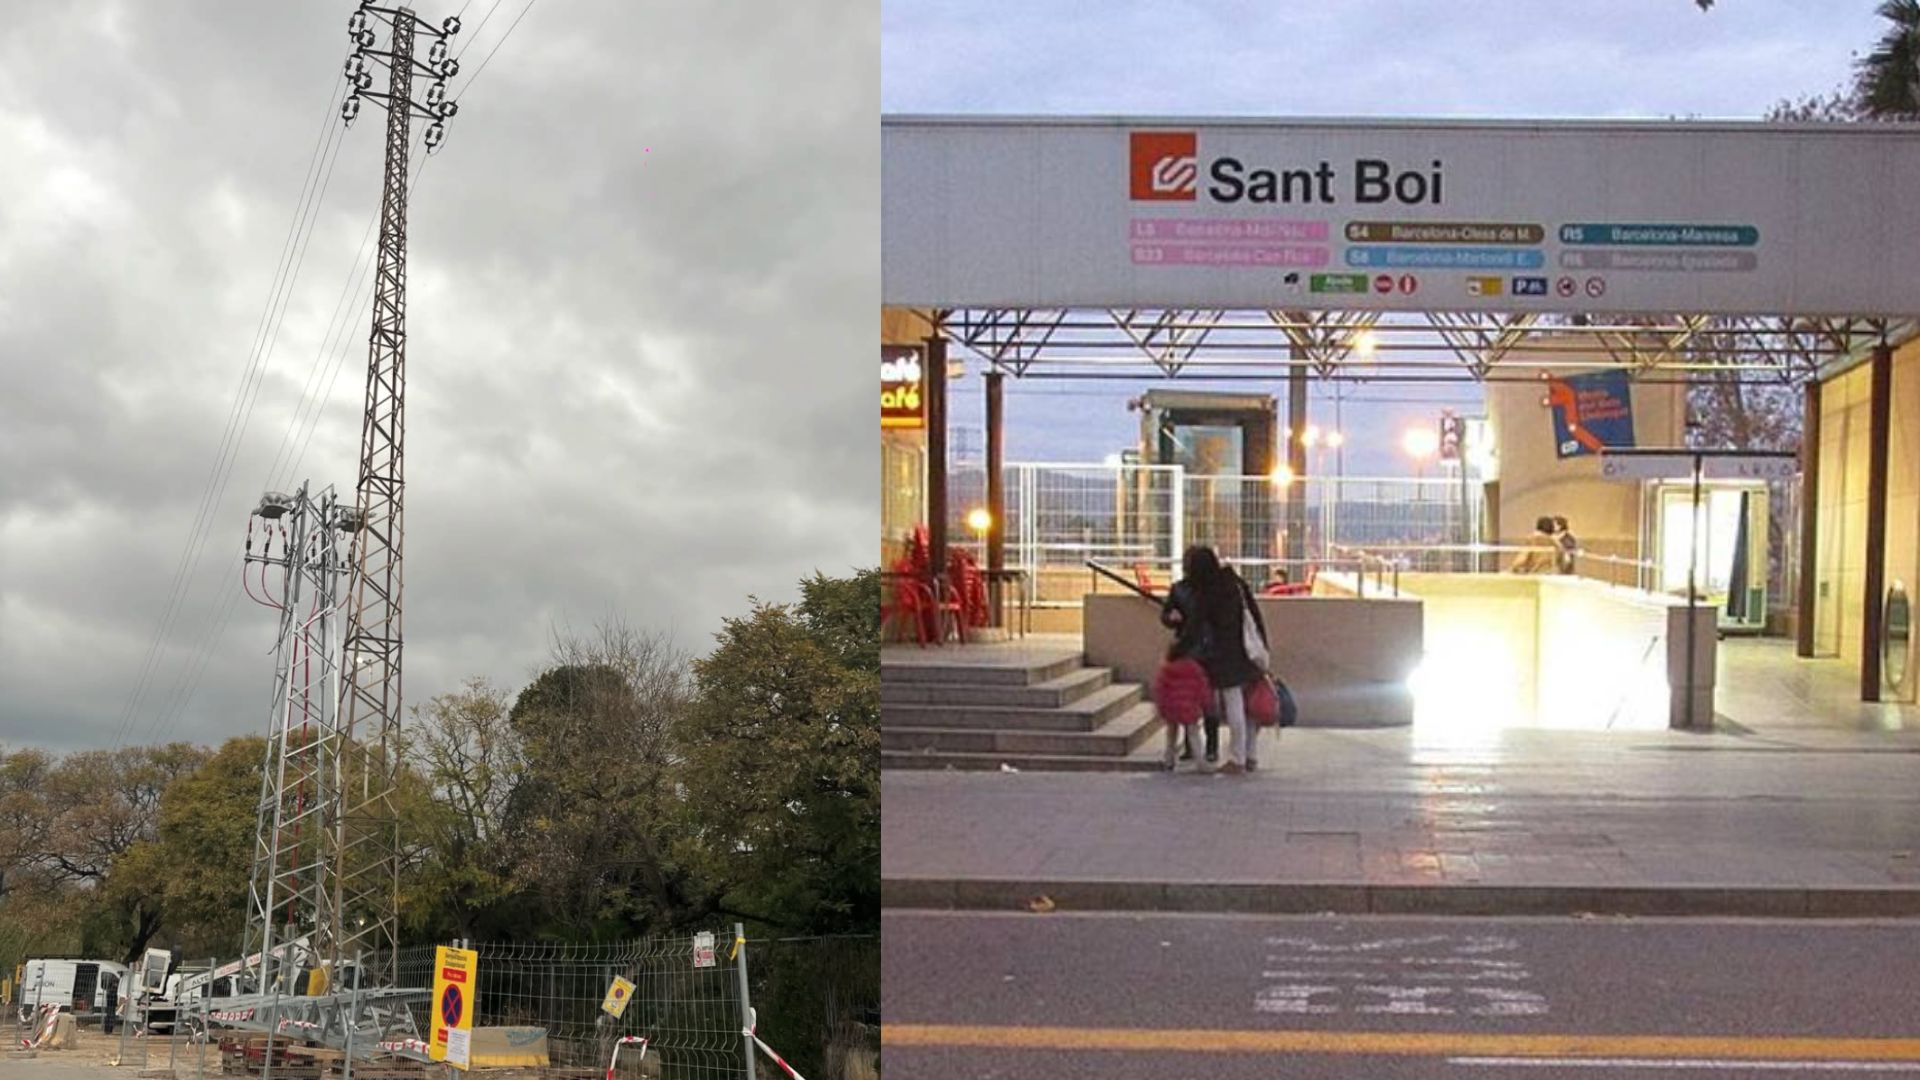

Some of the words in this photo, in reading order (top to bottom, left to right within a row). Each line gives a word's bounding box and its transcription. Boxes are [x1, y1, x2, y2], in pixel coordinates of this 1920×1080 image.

[1208, 157, 1335, 204] Sant
[1355, 160, 1441, 204] Boi
[1563, 227, 1584, 241] R5
[881, 349, 921, 381] afé
[881, 383, 920, 410] afé
